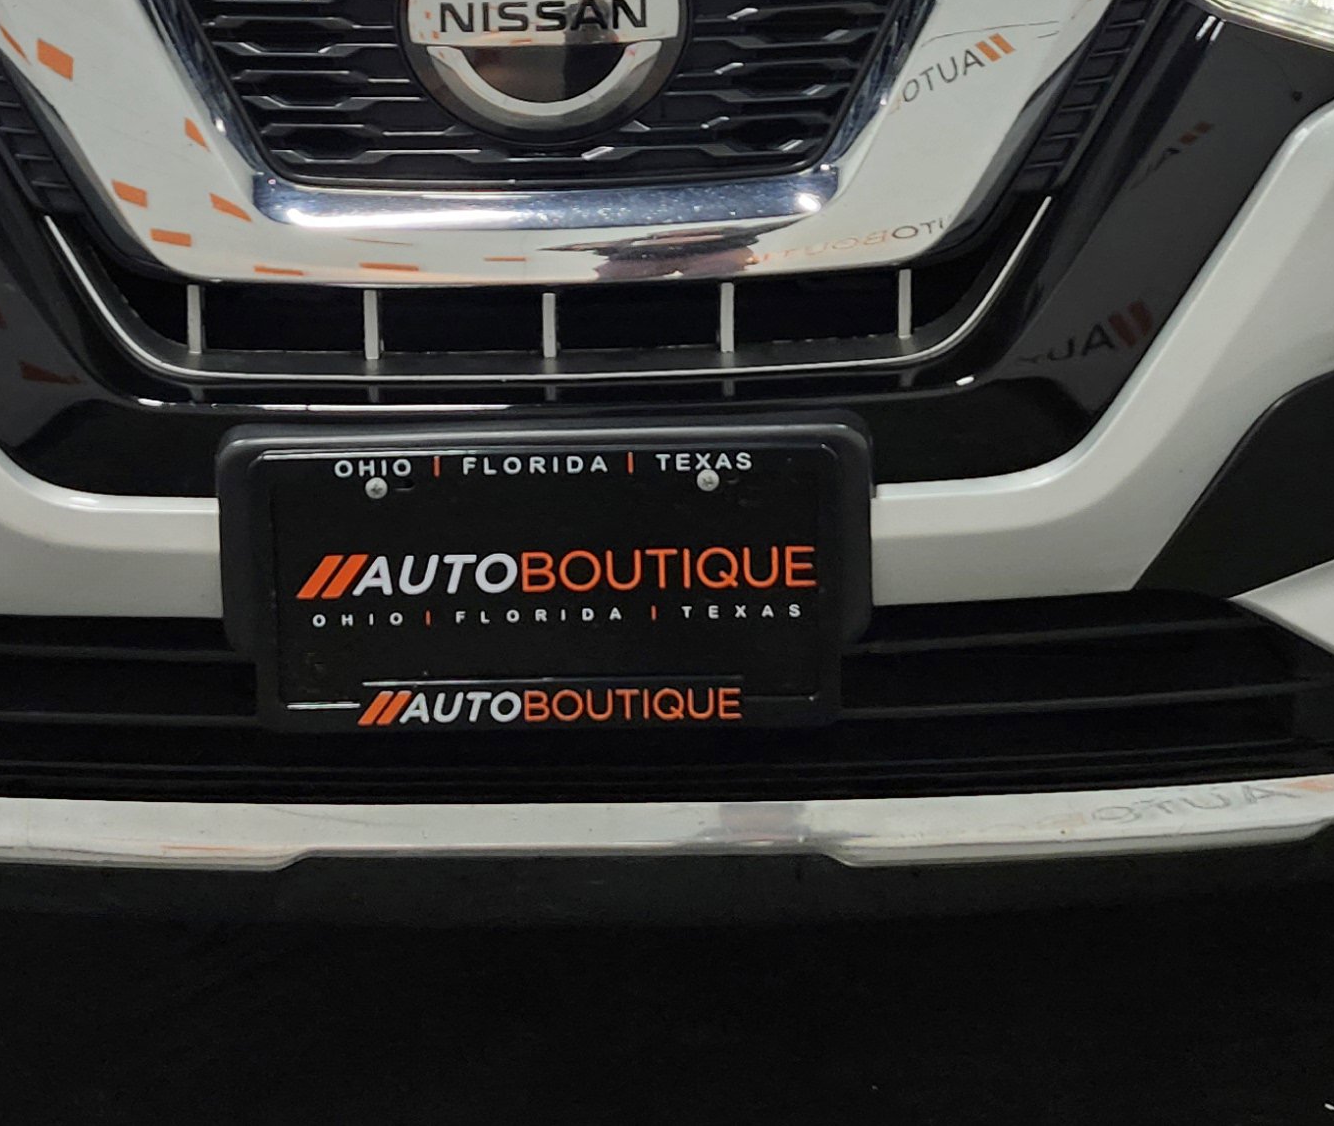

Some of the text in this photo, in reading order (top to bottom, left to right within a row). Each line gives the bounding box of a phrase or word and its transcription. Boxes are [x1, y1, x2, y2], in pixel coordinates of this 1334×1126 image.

[334, 451, 752, 478] OHIO FLORIDA TEXAS
[312, 603, 801, 628] OHIO FLORIDA TEXAS
